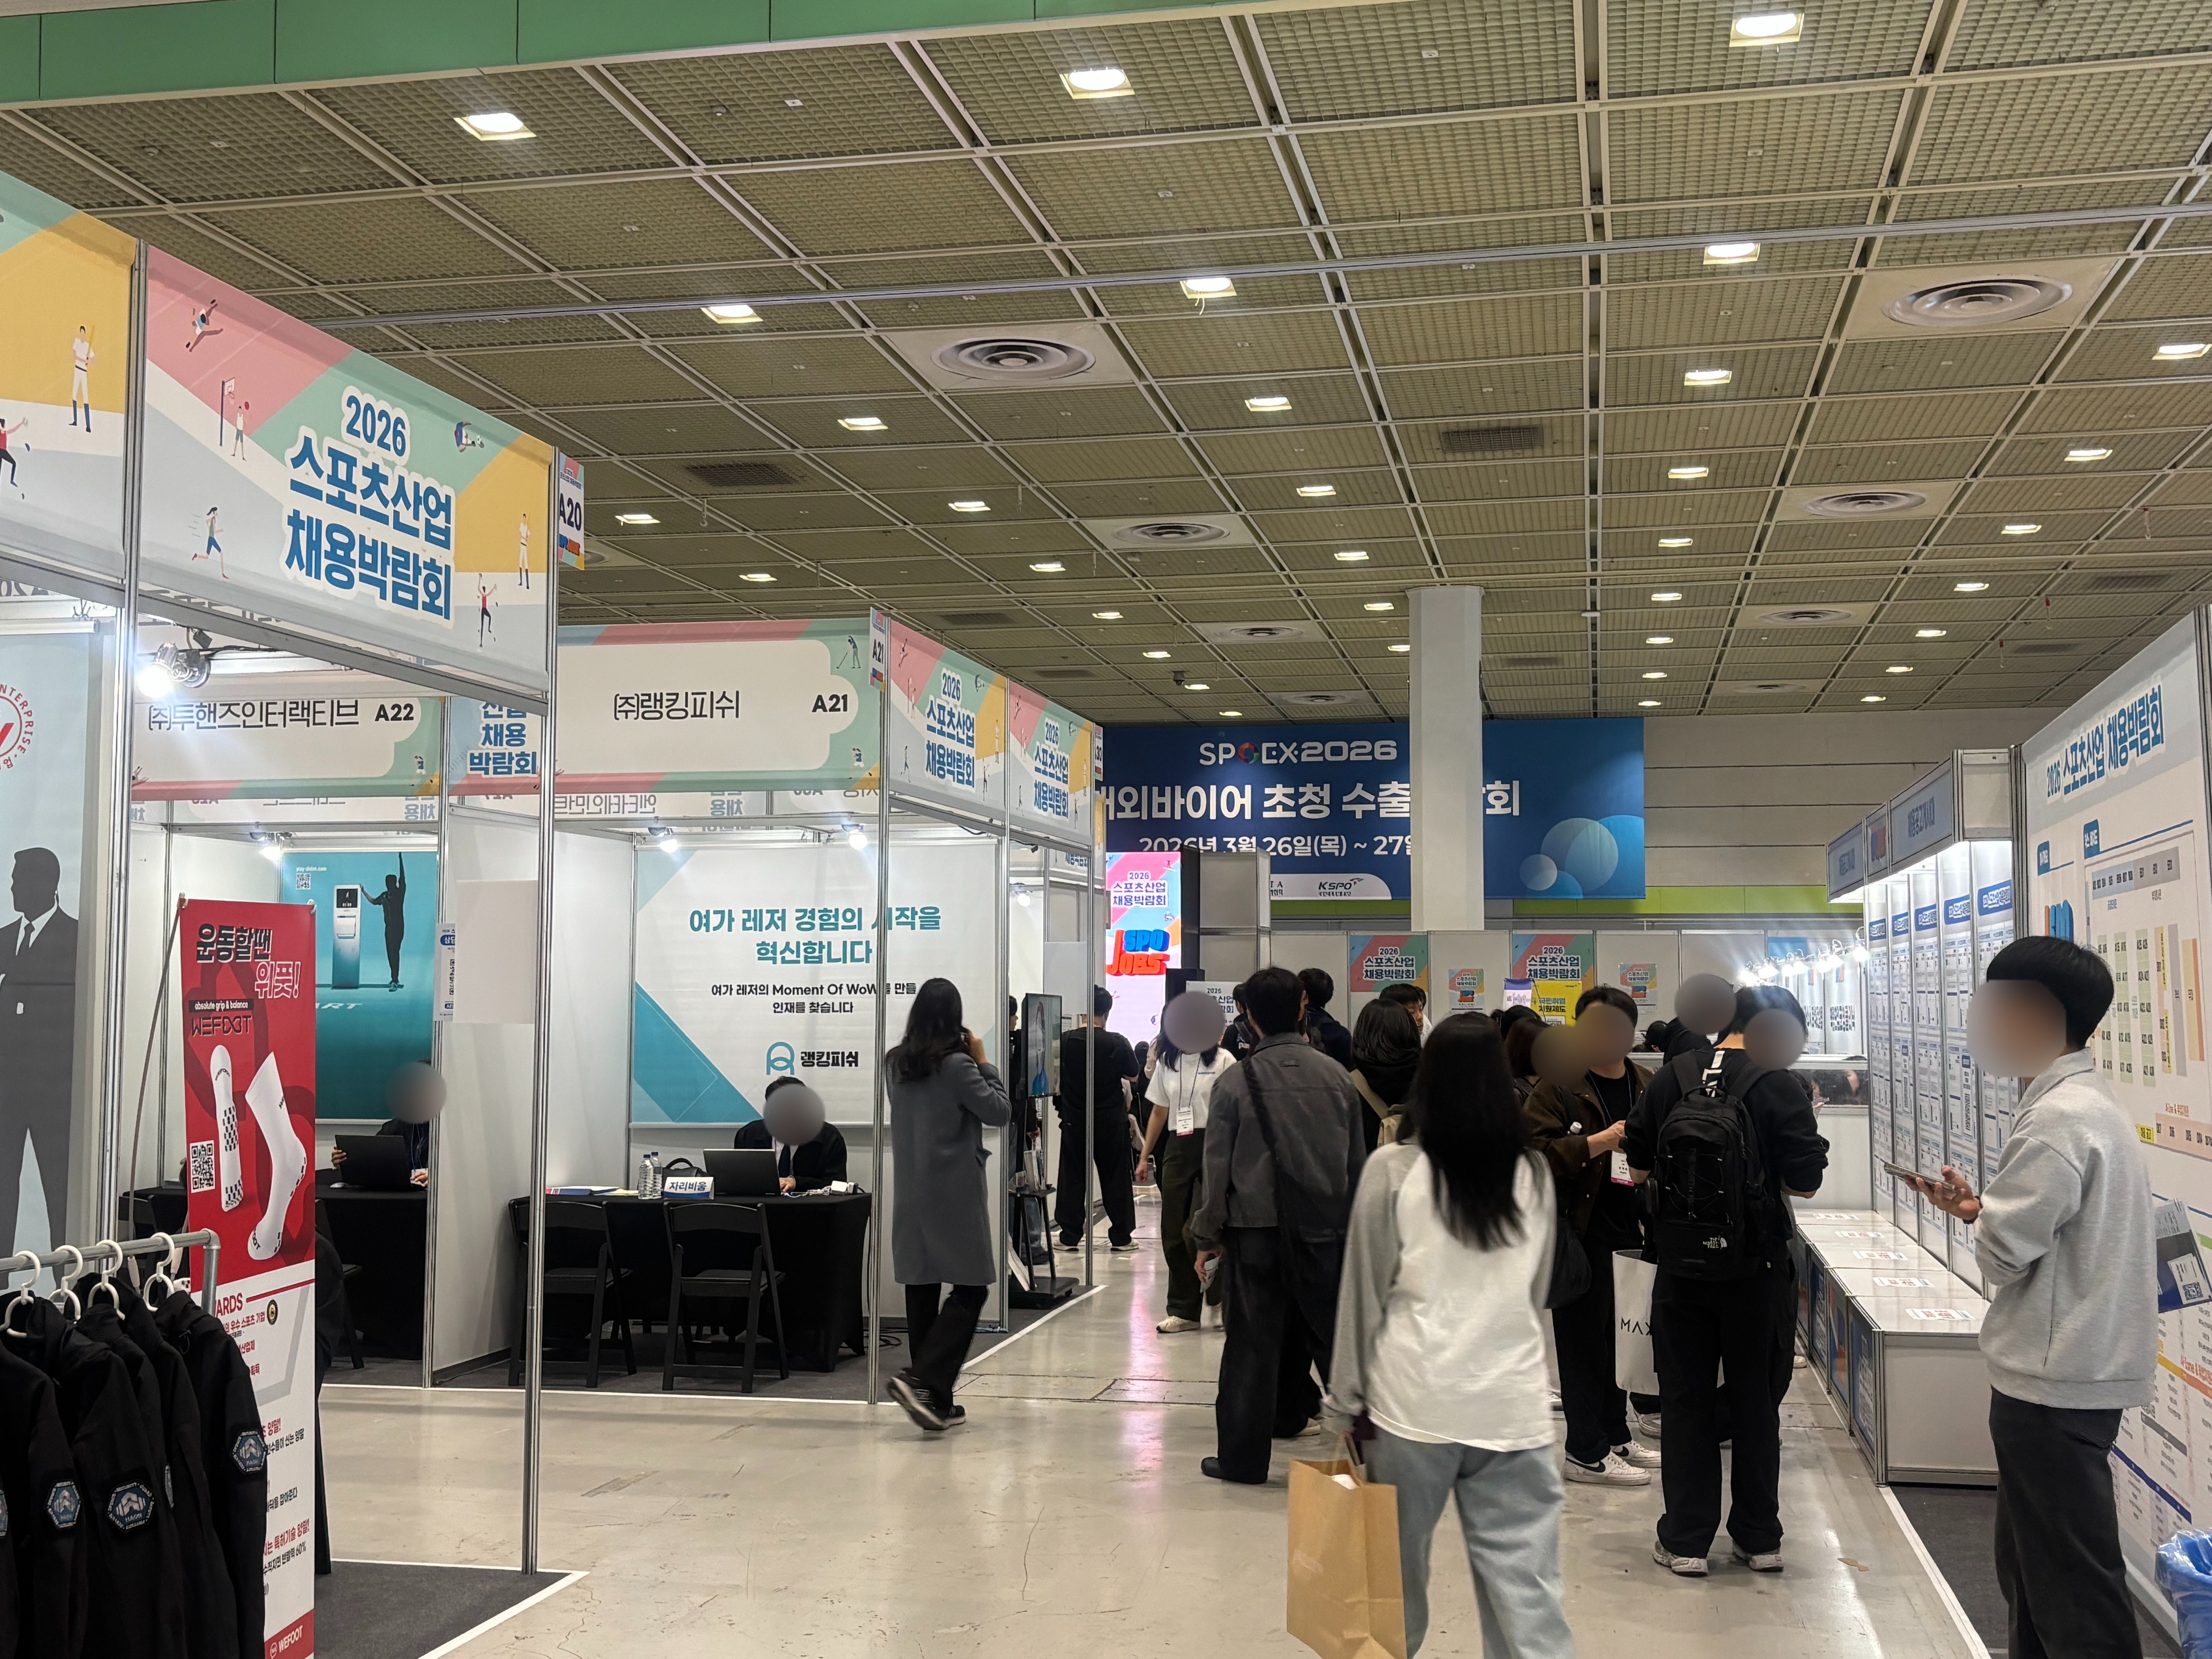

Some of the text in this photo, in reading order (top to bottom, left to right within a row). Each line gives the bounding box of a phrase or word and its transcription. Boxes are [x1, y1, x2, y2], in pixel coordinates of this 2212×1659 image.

[346, 395, 406, 457] 2026
[290, 436, 452, 550] 스포츠산업
[560, 493, 582, 531] A20
[287, 508, 451, 620] 채용박람회
[872, 639, 884, 664] A21
[942, 672, 960, 701] 2026
[375, 704, 414, 721] A22
[812, 694, 848, 713] A21
[482, 723, 526, 747] 채용
[926, 699, 974, 749] 스포츠산업
[1046, 720, 1058, 745] 2026
[2047, 684, 2164, 798] 2026 스포츠산업 채용박람회
[469, 751, 537, 775] 박람회
[926, 740, 974, 788] 채용박람회
[1034, 744, 1068, 785] 스포츠산업
[1034, 779, 1068, 818] 채용박람회
[1262, 783, 1331, 819] 초청
[1262, 835, 1346, 856] 26일(목)
[1113, 882, 1166, 893] 스포츠산업
[1319, 882, 1352, 890] KSPO
[1113, 895, 1166, 906] 채용박람회
[690, 909, 734, 932] 여가
[742, 908, 786, 932] 레저
[795, 907, 862, 931] 경험의
[756, 940, 872, 965] 혁신합니다
[1106, 929, 1170, 976] JOBS
[1124, 929, 1170, 952] SPO
[1364, 957, 1414, 967] 스포츠산업
[1527, 968, 1580, 979] 채용박람회
[1528, 956, 1580, 967] 스포츠산업
[254, 962, 301, 999] 위풋!
[1364, 969, 1415, 980] 채용박람회
[711, 984, 733, 996] 여가
[736, 984, 769, 996] 레저의
[773, 984, 824, 995] Moment
[828, 983, 843, 995] Of
[895, 984, 917, 995] 만들
[195, 1001, 215, 1010] absolute
[216, 1001, 225, 1011] grip
[230, 1000, 248, 1009] balance
[773, 1002, 854, 1013] 인재를 찾습니다
[800, 1051, 859, 1068] 랭킹피쉬
[669, 1181, 708, 1192] 자리비움
[215, 1292, 243, 1317] ARDS
[242, 1314, 255, 1328] 스포츠
[275, 1526, 296, 1549] 특허기술
[296, 1540, 307, 1556] 60%
[278, 1625, 303, 1653] WEFOOT
